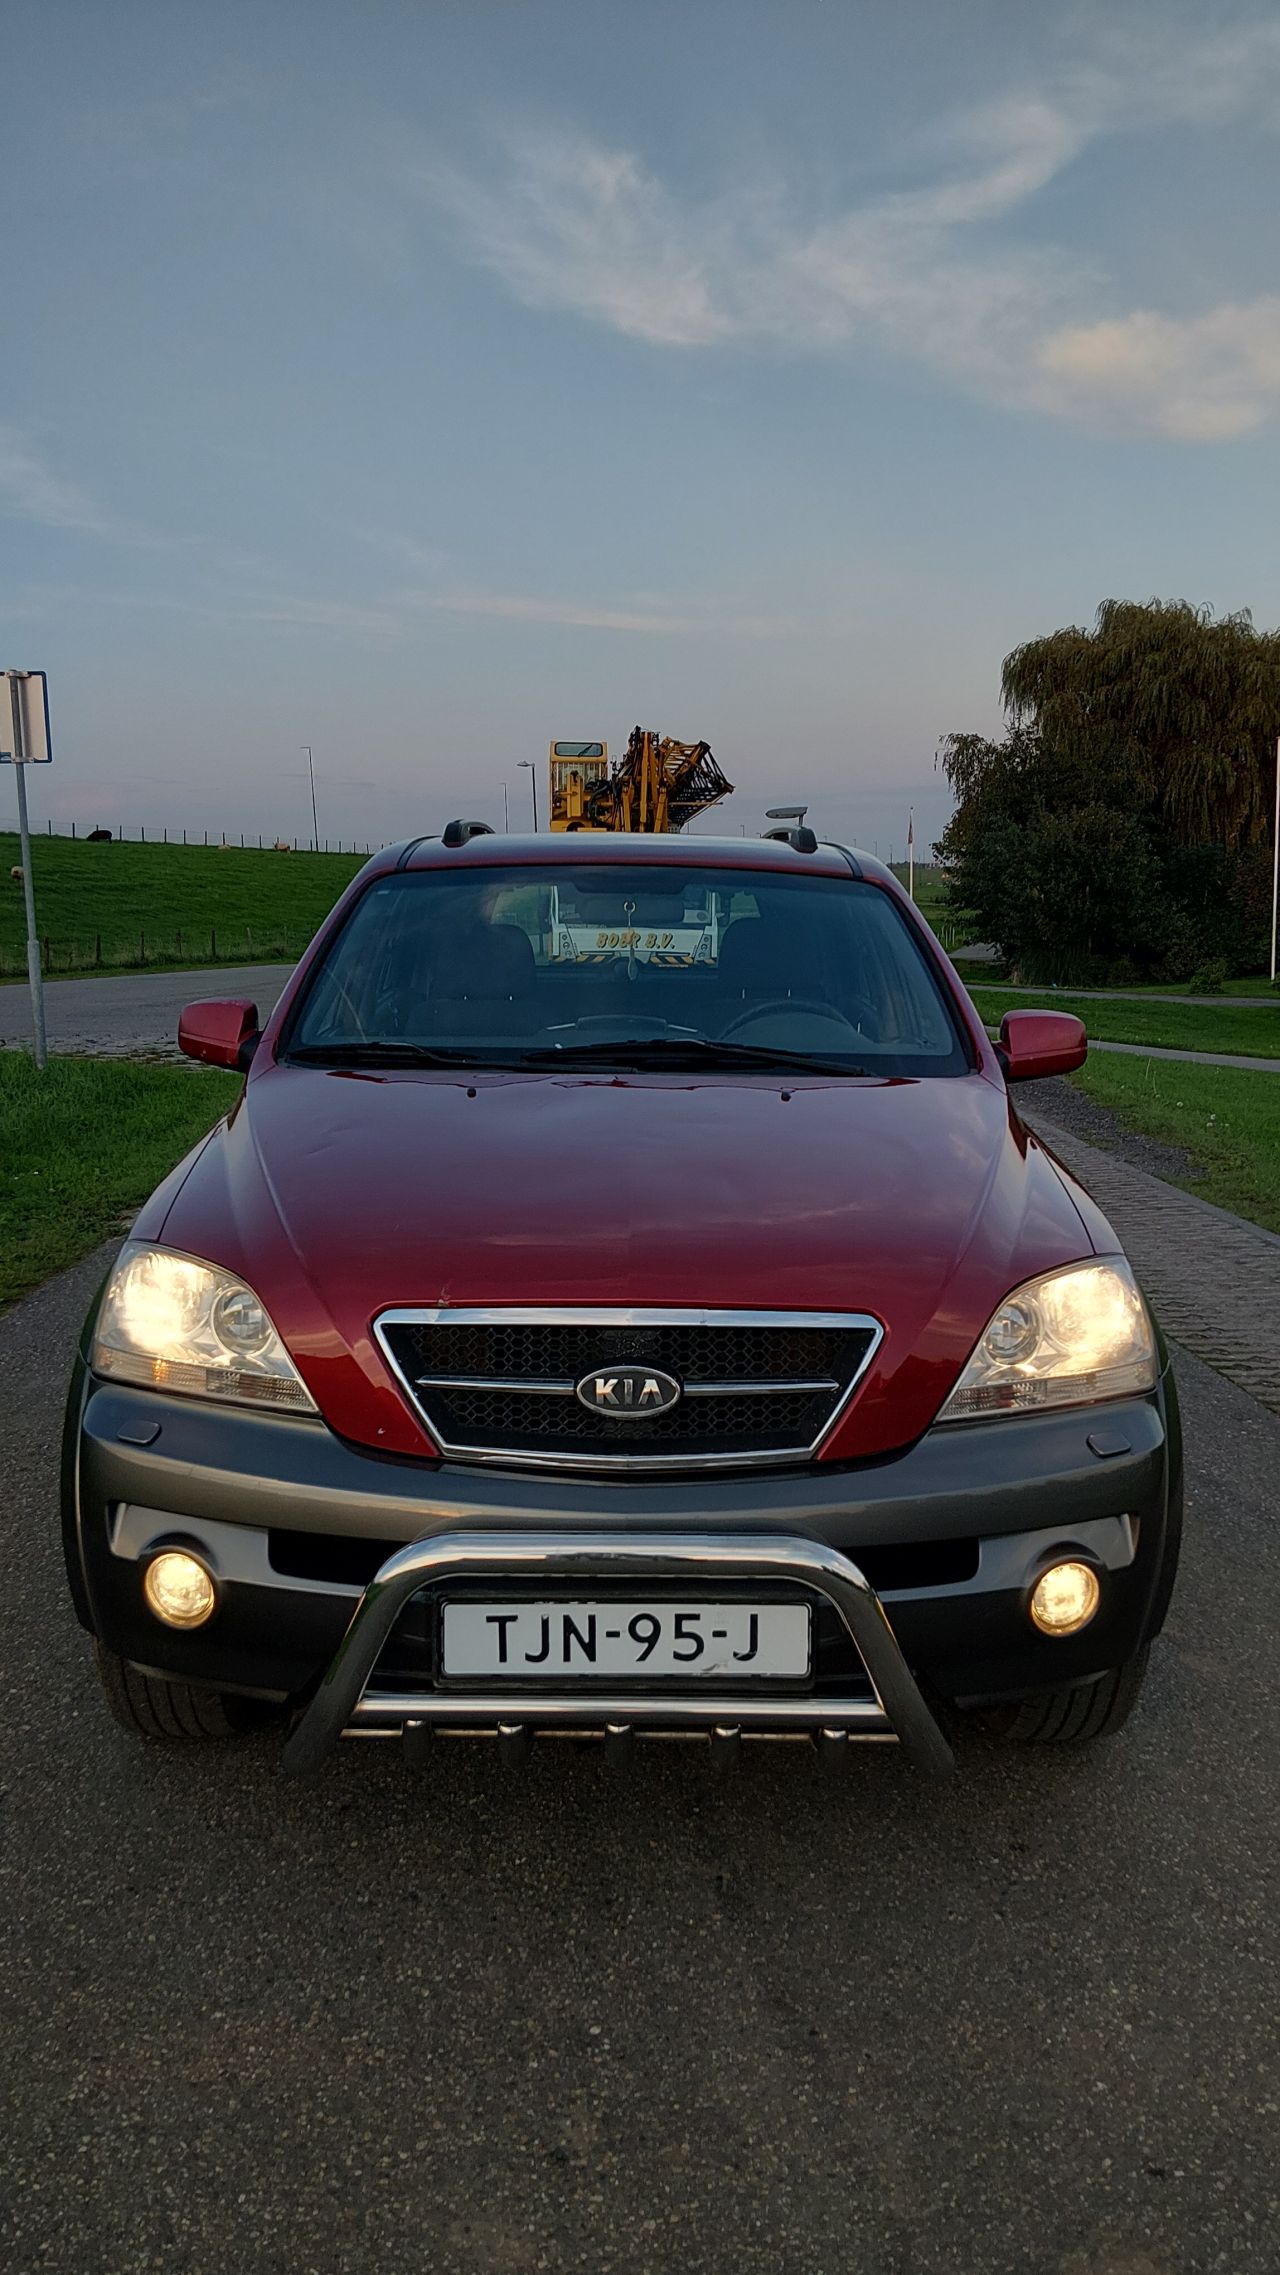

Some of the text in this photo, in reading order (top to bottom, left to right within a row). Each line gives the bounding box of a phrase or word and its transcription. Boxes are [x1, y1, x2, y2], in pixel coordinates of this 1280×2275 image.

[645, 933, 675, 949] B.V.
[594, 1378, 664, 1405] KIA
[486, 1612, 759, 1663] TJN-95-J
